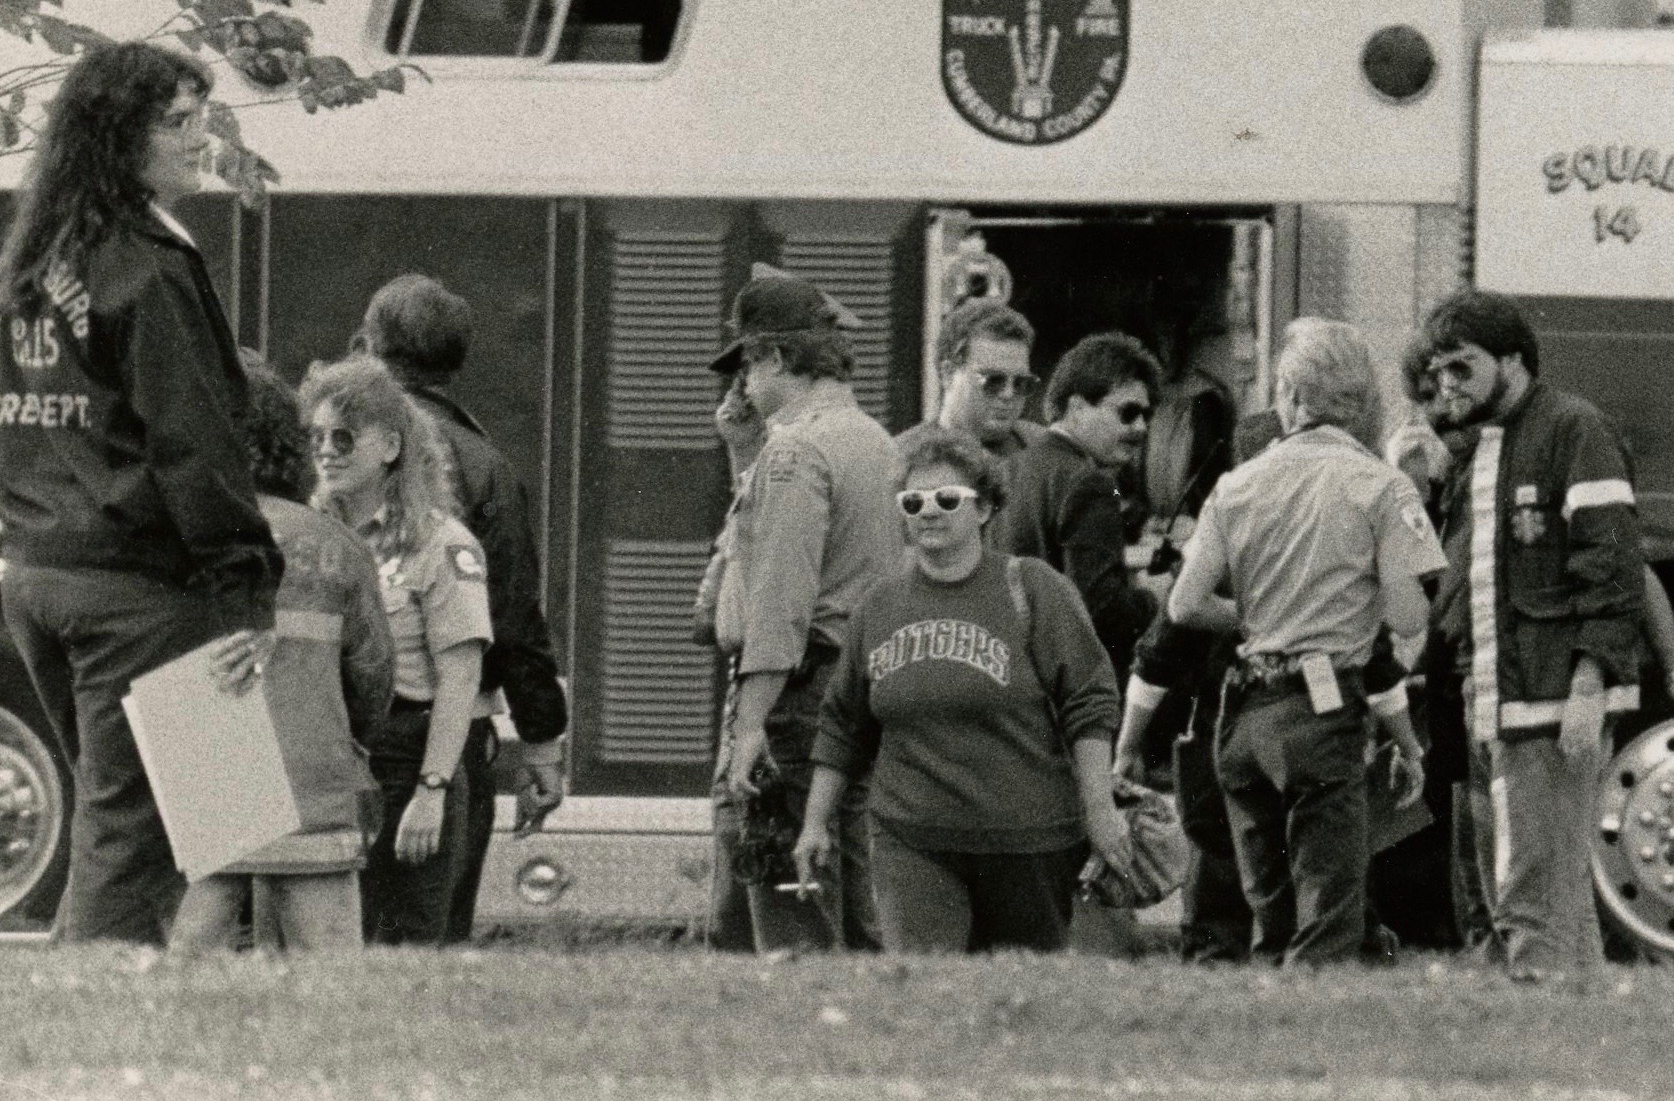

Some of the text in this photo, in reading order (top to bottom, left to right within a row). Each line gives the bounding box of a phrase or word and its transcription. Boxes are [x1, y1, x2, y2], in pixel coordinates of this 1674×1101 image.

[947, 15, 1006, 35] TRUCK
[1075, 17, 1120, 36] FIRE
[946, 49, 1037, 140] CUMBERLAND
[1043, 84, 1108, 137] COUNTY
[1592, 204, 1642, 244] 14
[868, 618, 1011, 688] RUTGERS
